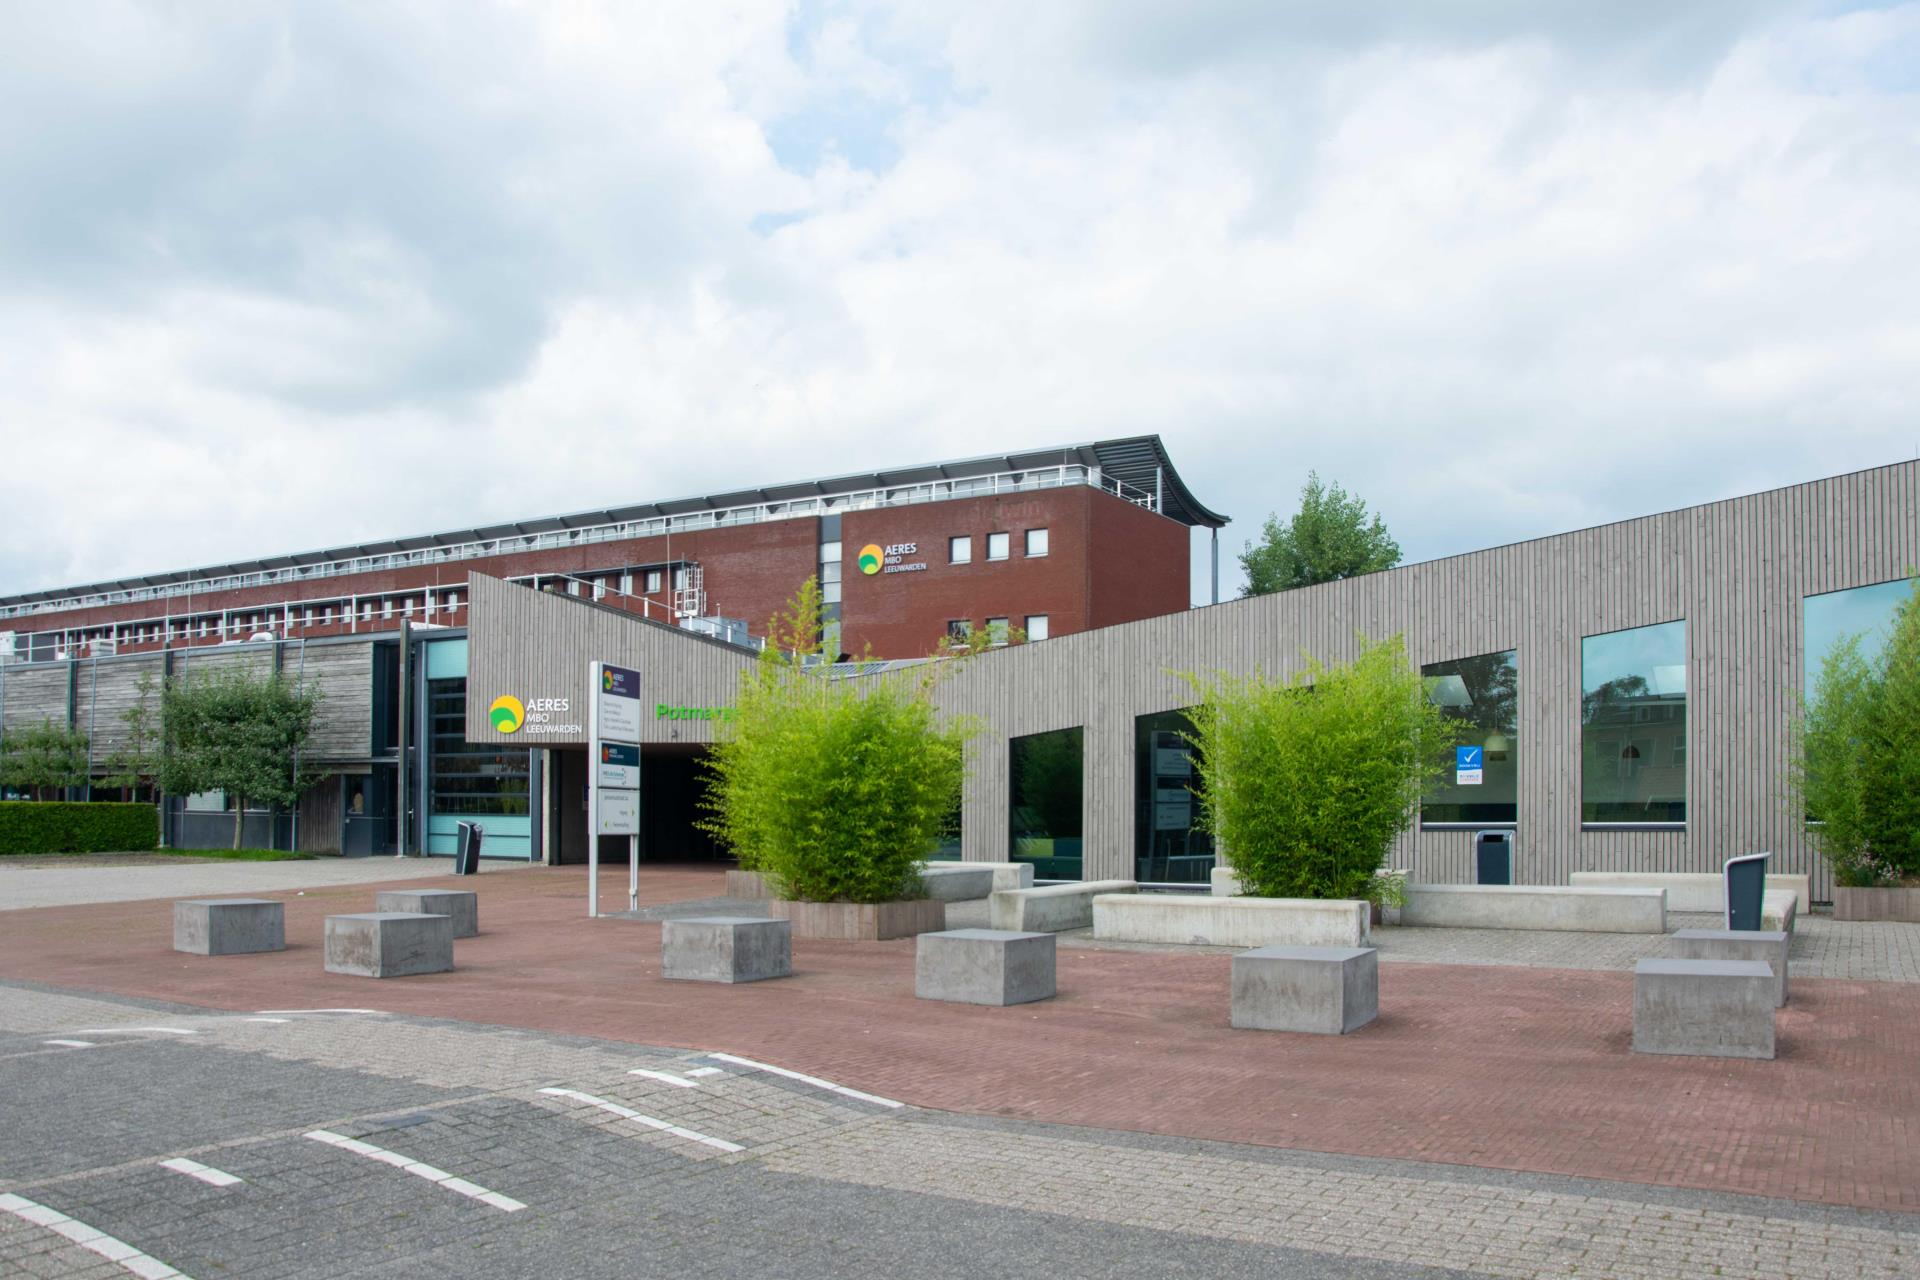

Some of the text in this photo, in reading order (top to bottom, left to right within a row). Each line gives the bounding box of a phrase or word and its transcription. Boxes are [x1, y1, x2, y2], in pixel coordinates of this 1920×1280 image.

[884, 543, 917, 556] AERES
[884, 556, 902, 565] MBO
[884, 563, 927, 573] LEEUWARDEN
[526, 699, 569, 711] AERES
[526, 713, 550, 723] MBO
[656, 703, 742, 723] Potmar
[526, 725, 582, 733] LEEUWARDEN
